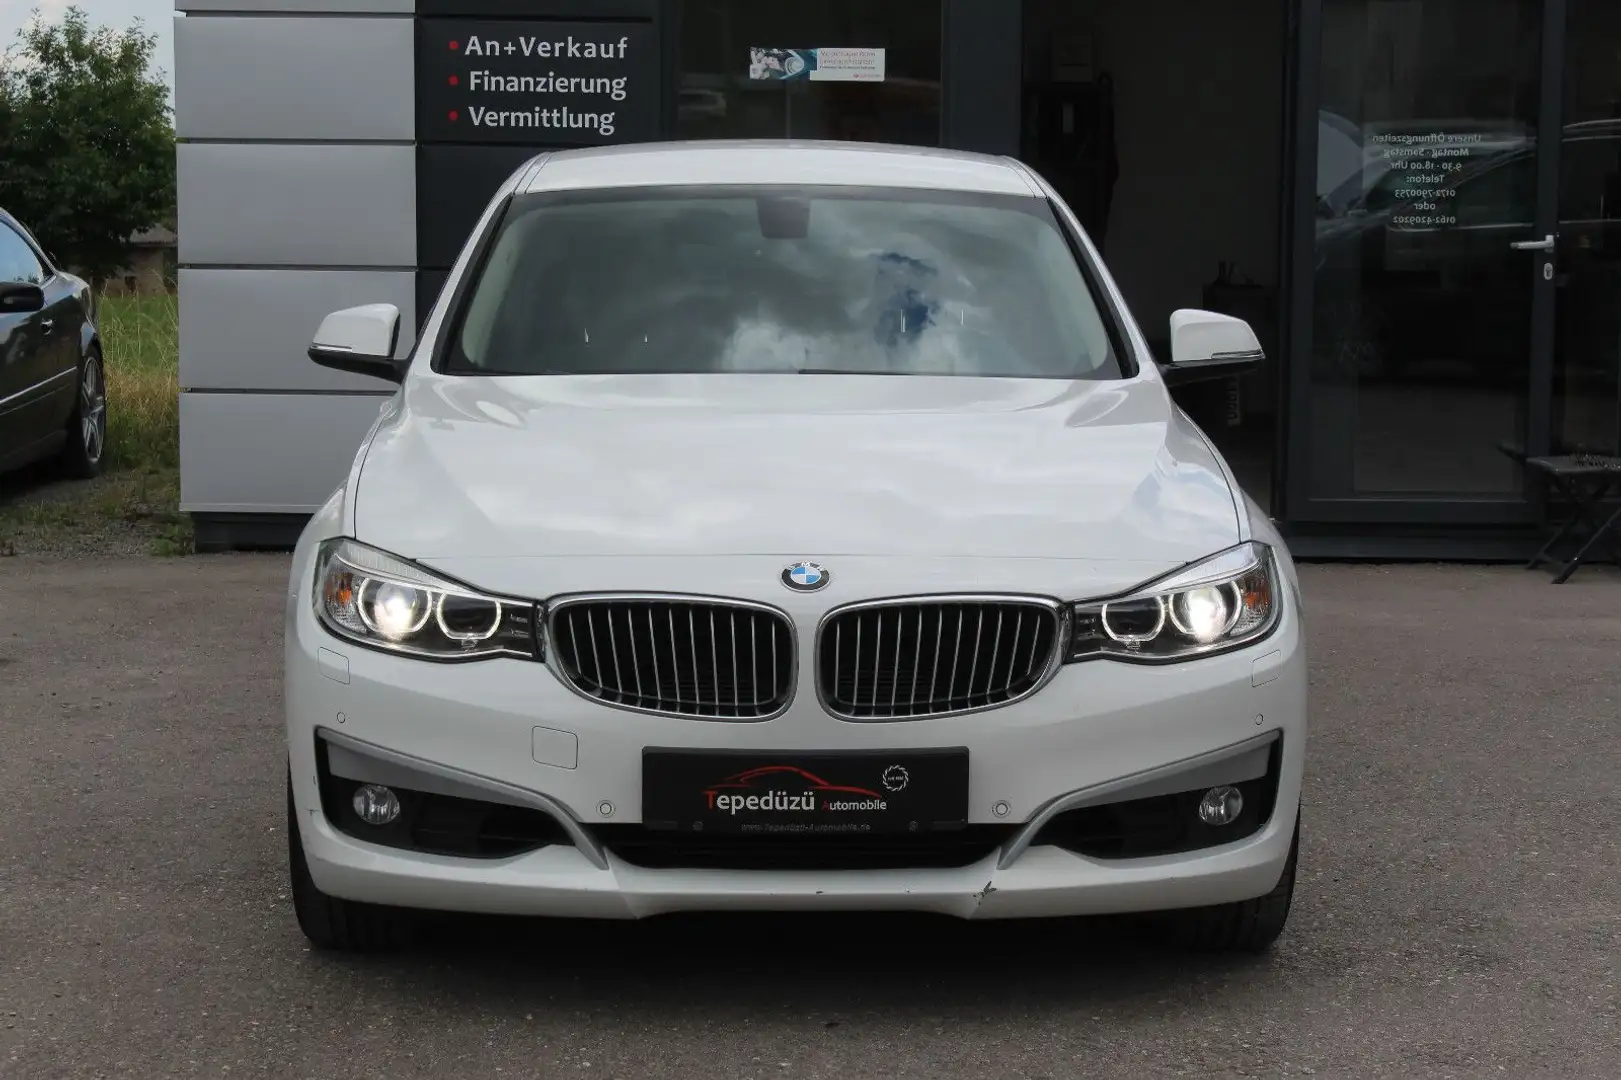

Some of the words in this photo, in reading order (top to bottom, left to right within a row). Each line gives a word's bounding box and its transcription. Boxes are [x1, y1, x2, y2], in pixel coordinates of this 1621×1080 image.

[464, 35, 628, 59] An+Verkauf
[469, 69, 628, 101] Finanzierung
[468, 106, 615, 136] Vermittlung
[702, 790, 815, 816] Tepedüzü
[822, 799, 887, 811] Automobile
